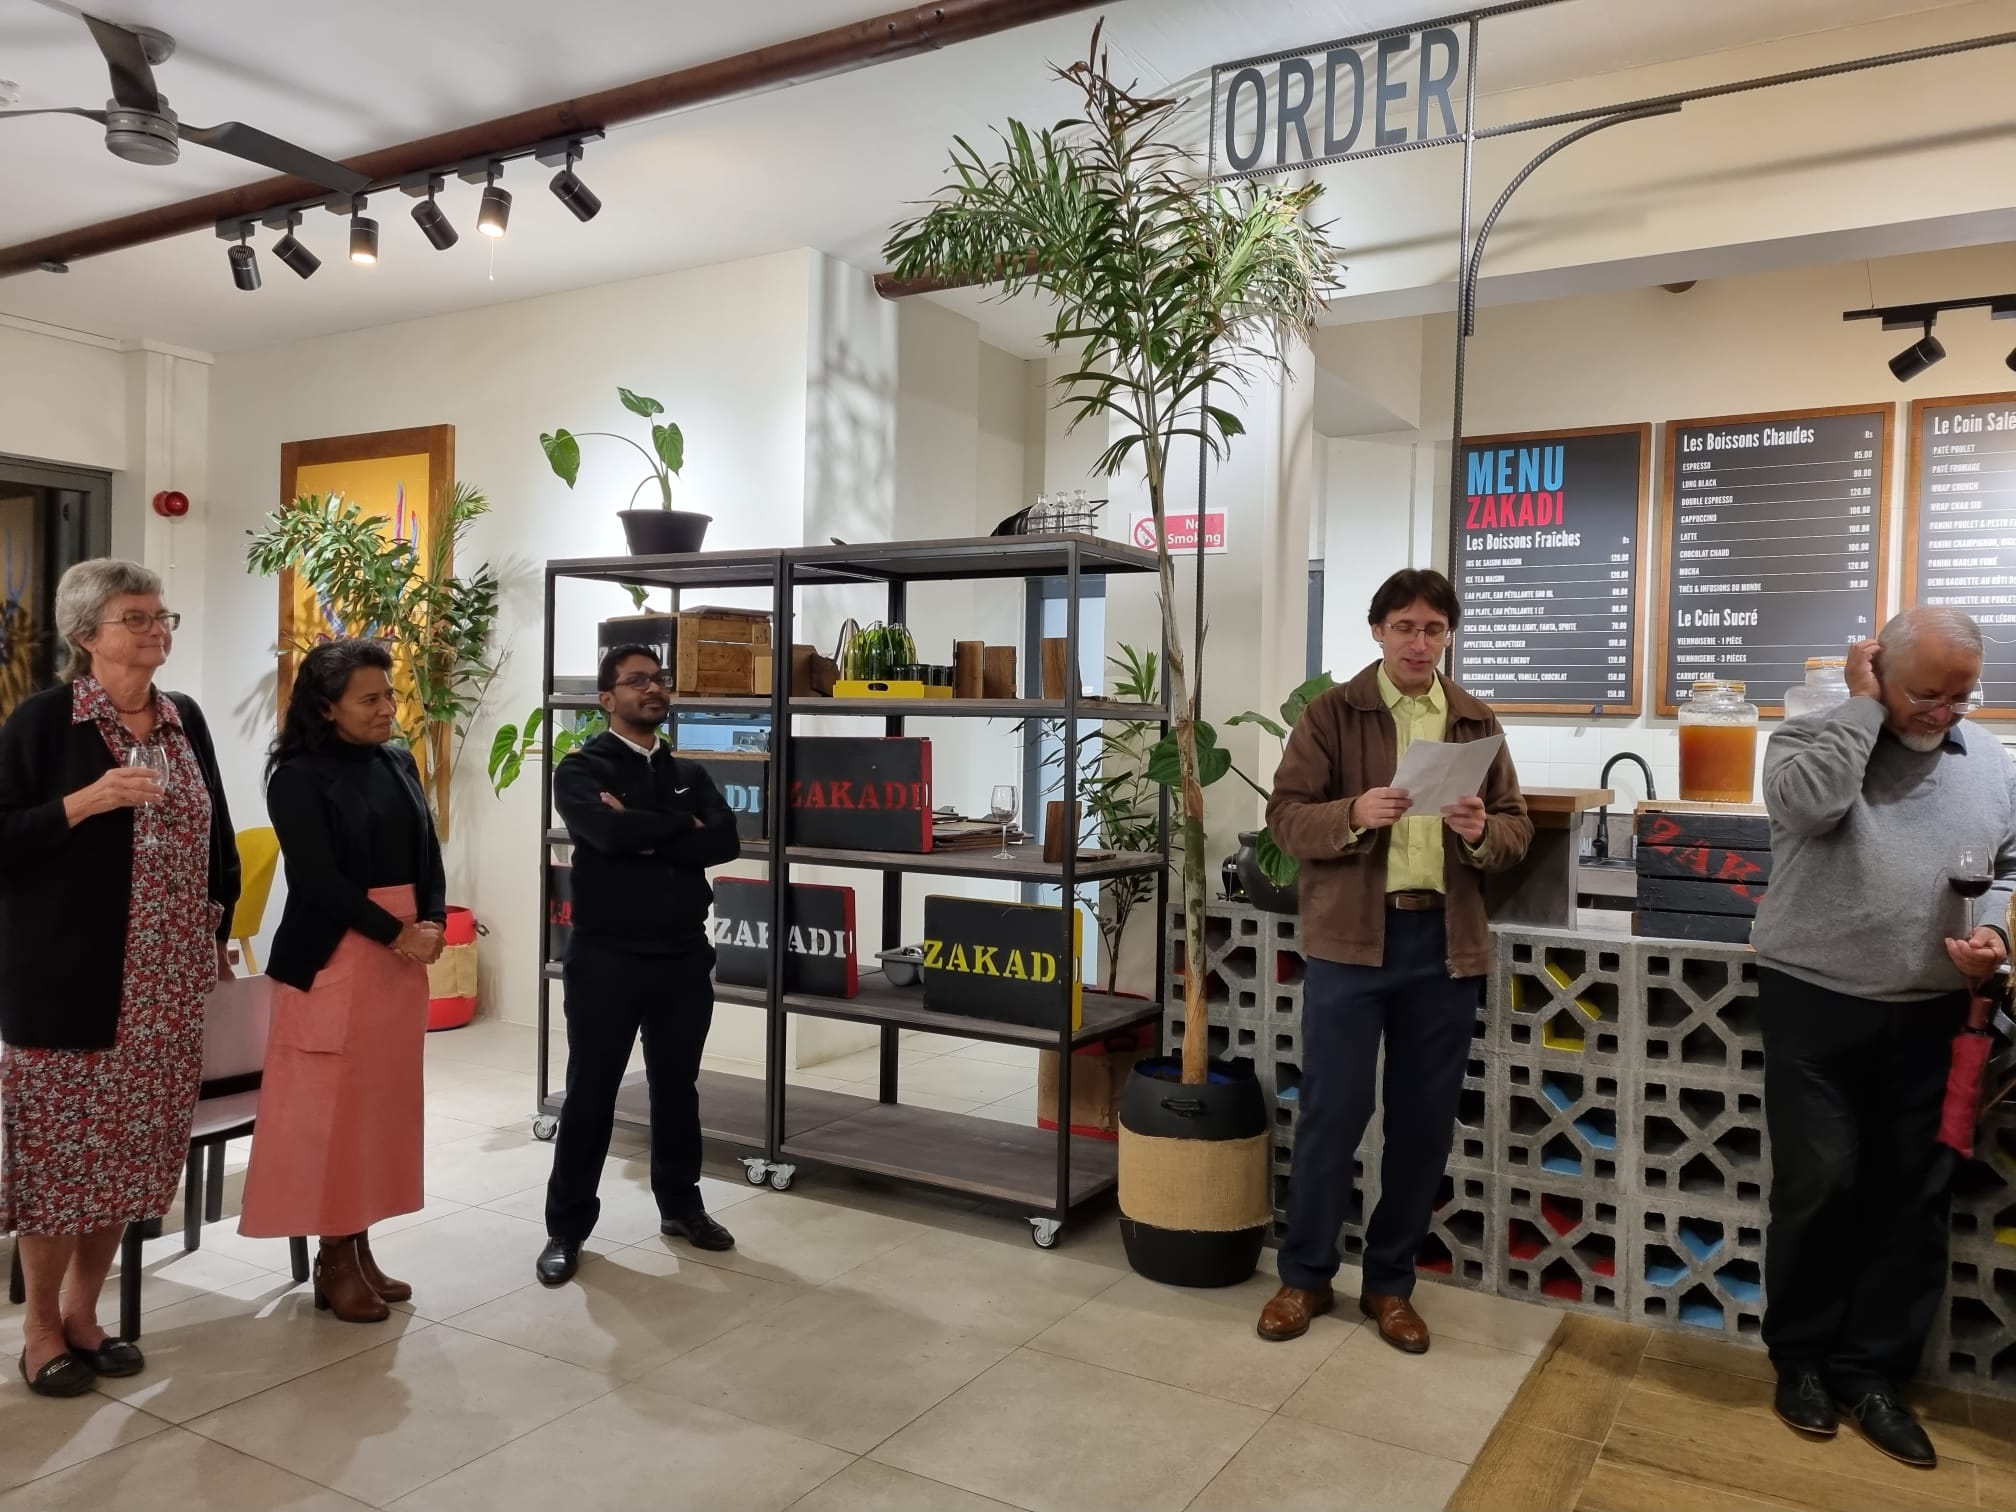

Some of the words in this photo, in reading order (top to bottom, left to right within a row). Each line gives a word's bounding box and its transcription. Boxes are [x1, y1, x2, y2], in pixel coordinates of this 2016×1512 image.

[1225, 27, 1460, 172] ORDER
[1934, 416, 1949, 435] Le
[1954, 414, 1982, 434] Coin
[1683, 434, 1703, 452] Les
[1706, 431, 1760, 451] Boissons
[1763, 426, 1815, 445] Chaudes
[1682, 461, 1712, 471] ESPRESSO
[1854, 450, 1873, 459] 85.00
[1467, 445, 1565, 496] MENU
[1682, 479, 1697, 488] LONG
[1698, 478, 1718, 488] BLACK
[1681, 496, 1704, 506] DOUBLE
[1704, 495, 1734, 505] ESPRESSO
[1465, 491, 1564, 530] ZAKADI
[1681, 513, 1717, 523] CAPPUCCINO
[1466, 534, 1484, 551] Les
[1486, 532, 1532, 551] Boissons
[1535, 530, 1582, 548] Fraîches
[1680, 532, 1698, 541] LATTE
[1679, 549, 1709, 558] CHOCOLAT
[1710, 548, 1730, 557] CHAUD
[1679, 583, 1693, 593] THÉS
[1700, 583, 1731, 593] INFUSIONS
[1678, 609, 1692, 627] Le
[1695, 608, 1720, 627] Coin
[1723, 608, 1758, 627] Sucré
[1726, 635, 1743, 645] PIÈCE
[1726, 652, 1747, 663] PIÈCES
